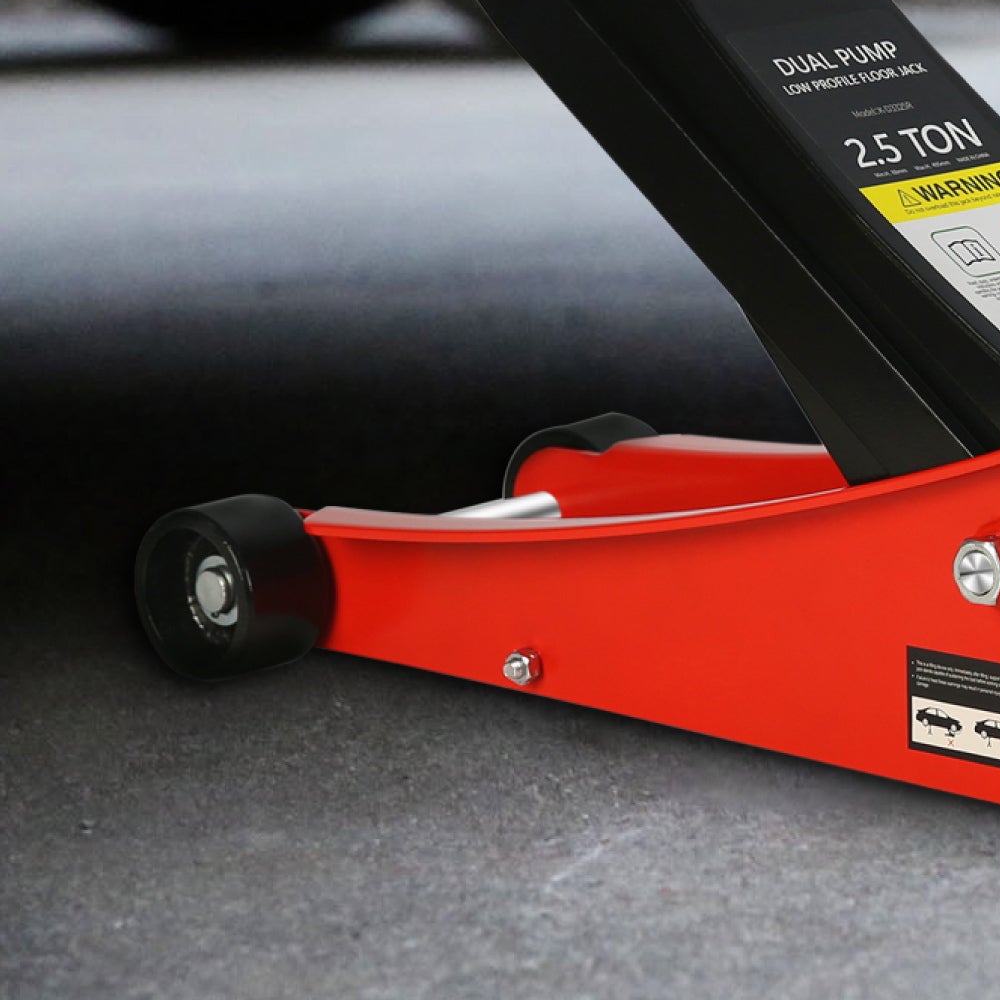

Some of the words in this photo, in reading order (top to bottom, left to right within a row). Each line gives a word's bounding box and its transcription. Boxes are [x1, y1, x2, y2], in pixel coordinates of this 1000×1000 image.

[772, 52, 838, 77] DUAL
[834, 40, 898, 67] PUMP
[782, 80, 812, 96] LOW
[814, 73, 861, 92] PROFILE
[858, 67, 900, 85] FLOOR
[897, 62, 928, 77] JACK
[843, 133, 903, 169] 2.5
[897, 118, 983, 158] TON
